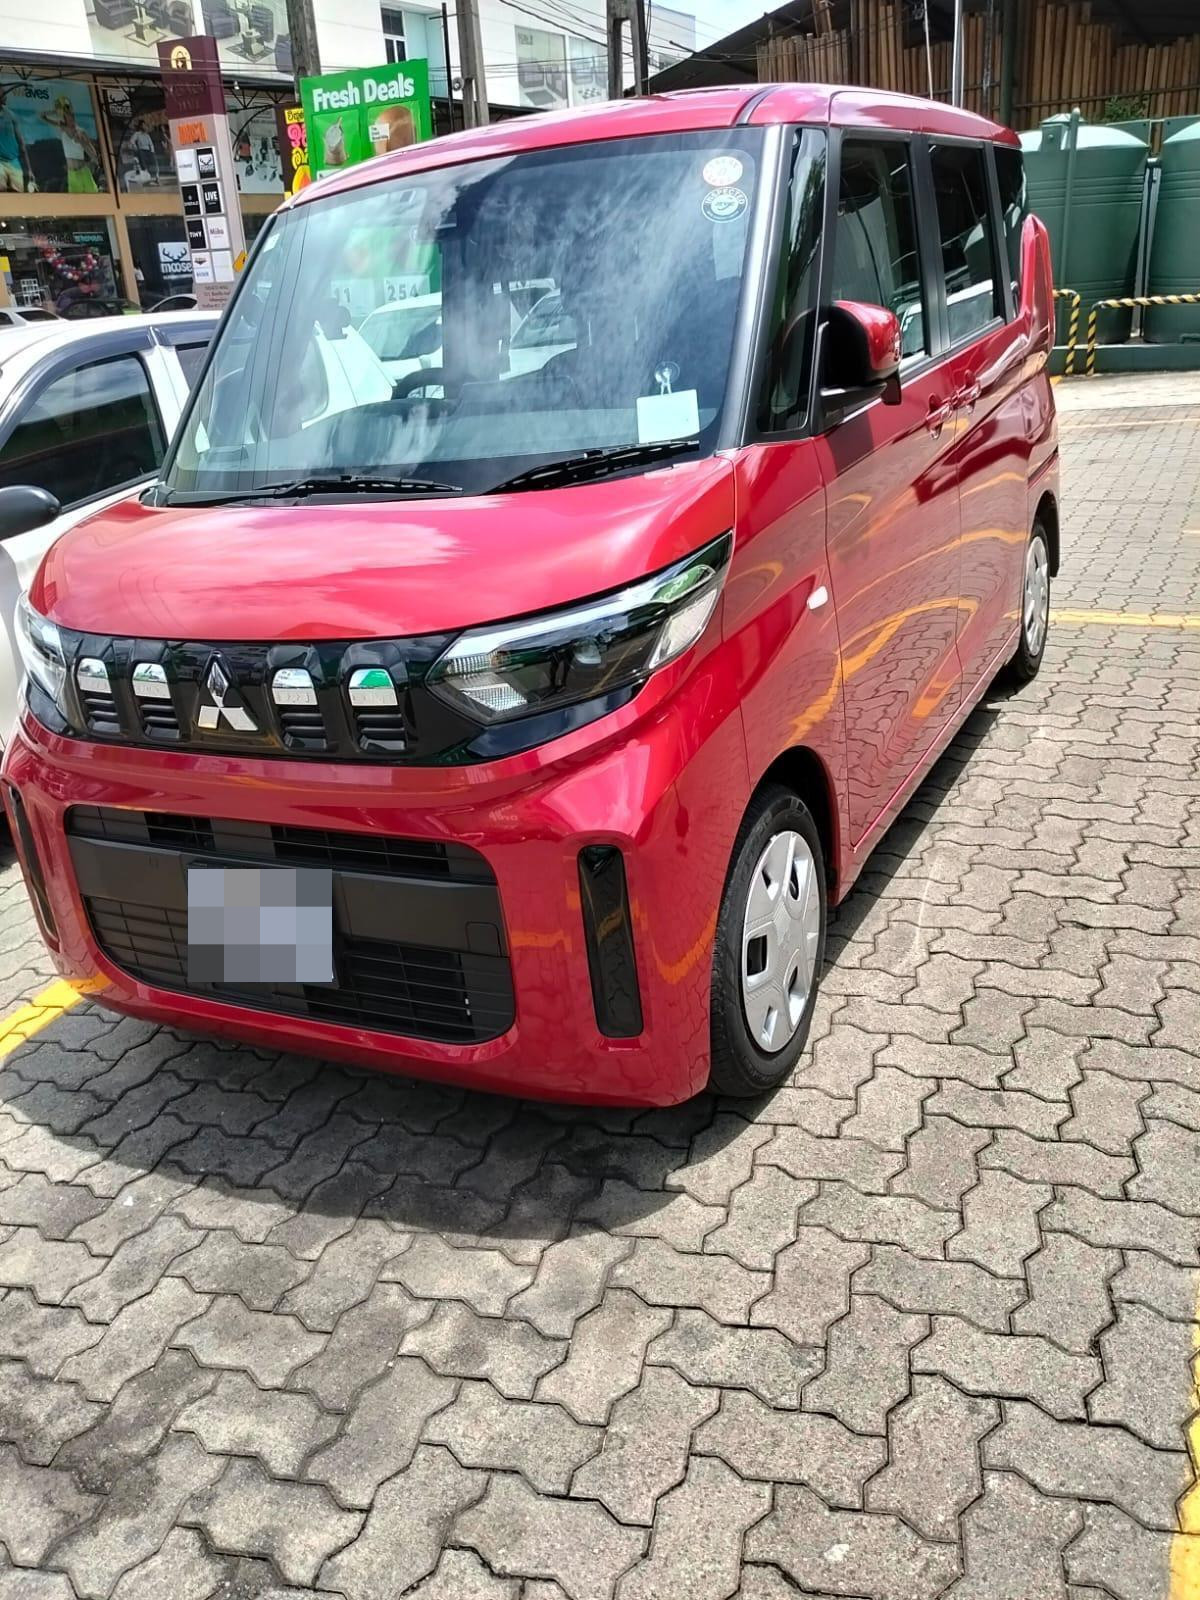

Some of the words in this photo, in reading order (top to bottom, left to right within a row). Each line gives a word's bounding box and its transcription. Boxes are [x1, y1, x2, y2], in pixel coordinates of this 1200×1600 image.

[312, 80, 360, 113] Fresh
[363, 72, 415, 103] Deals
[204, 191, 218, 201] LIVE
[704, 188, 746, 205] INSPECTED
[161, 262, 193, 273] moose
